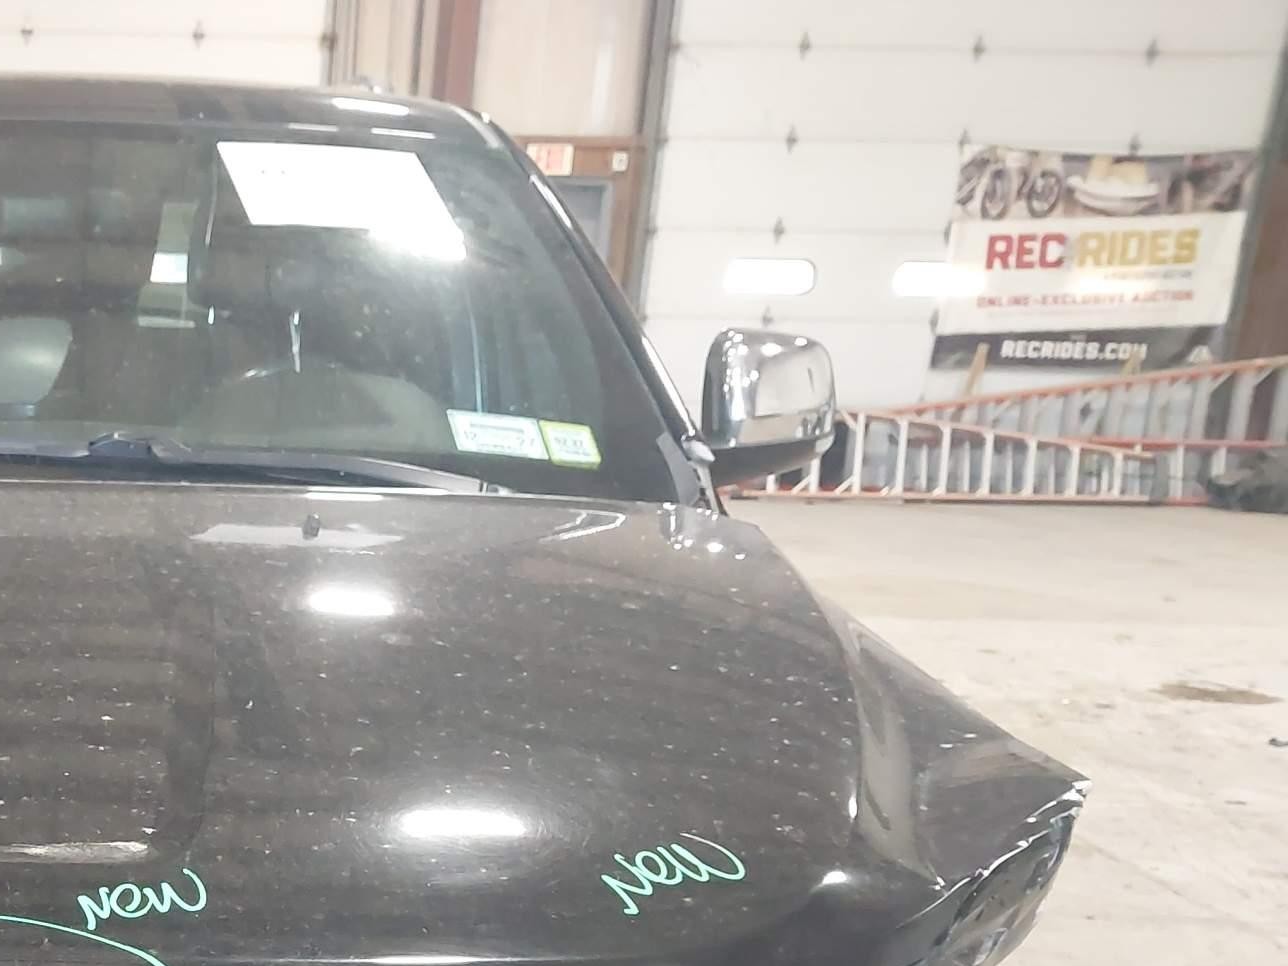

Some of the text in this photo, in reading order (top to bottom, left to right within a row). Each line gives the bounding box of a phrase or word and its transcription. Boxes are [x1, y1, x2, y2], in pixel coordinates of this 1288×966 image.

[987, 229, 1199, 270] REC RIDES
[1132, 290, 1195, 303] AUCTION
[1000, 340, 1147, 359] RECRIDES.COM
